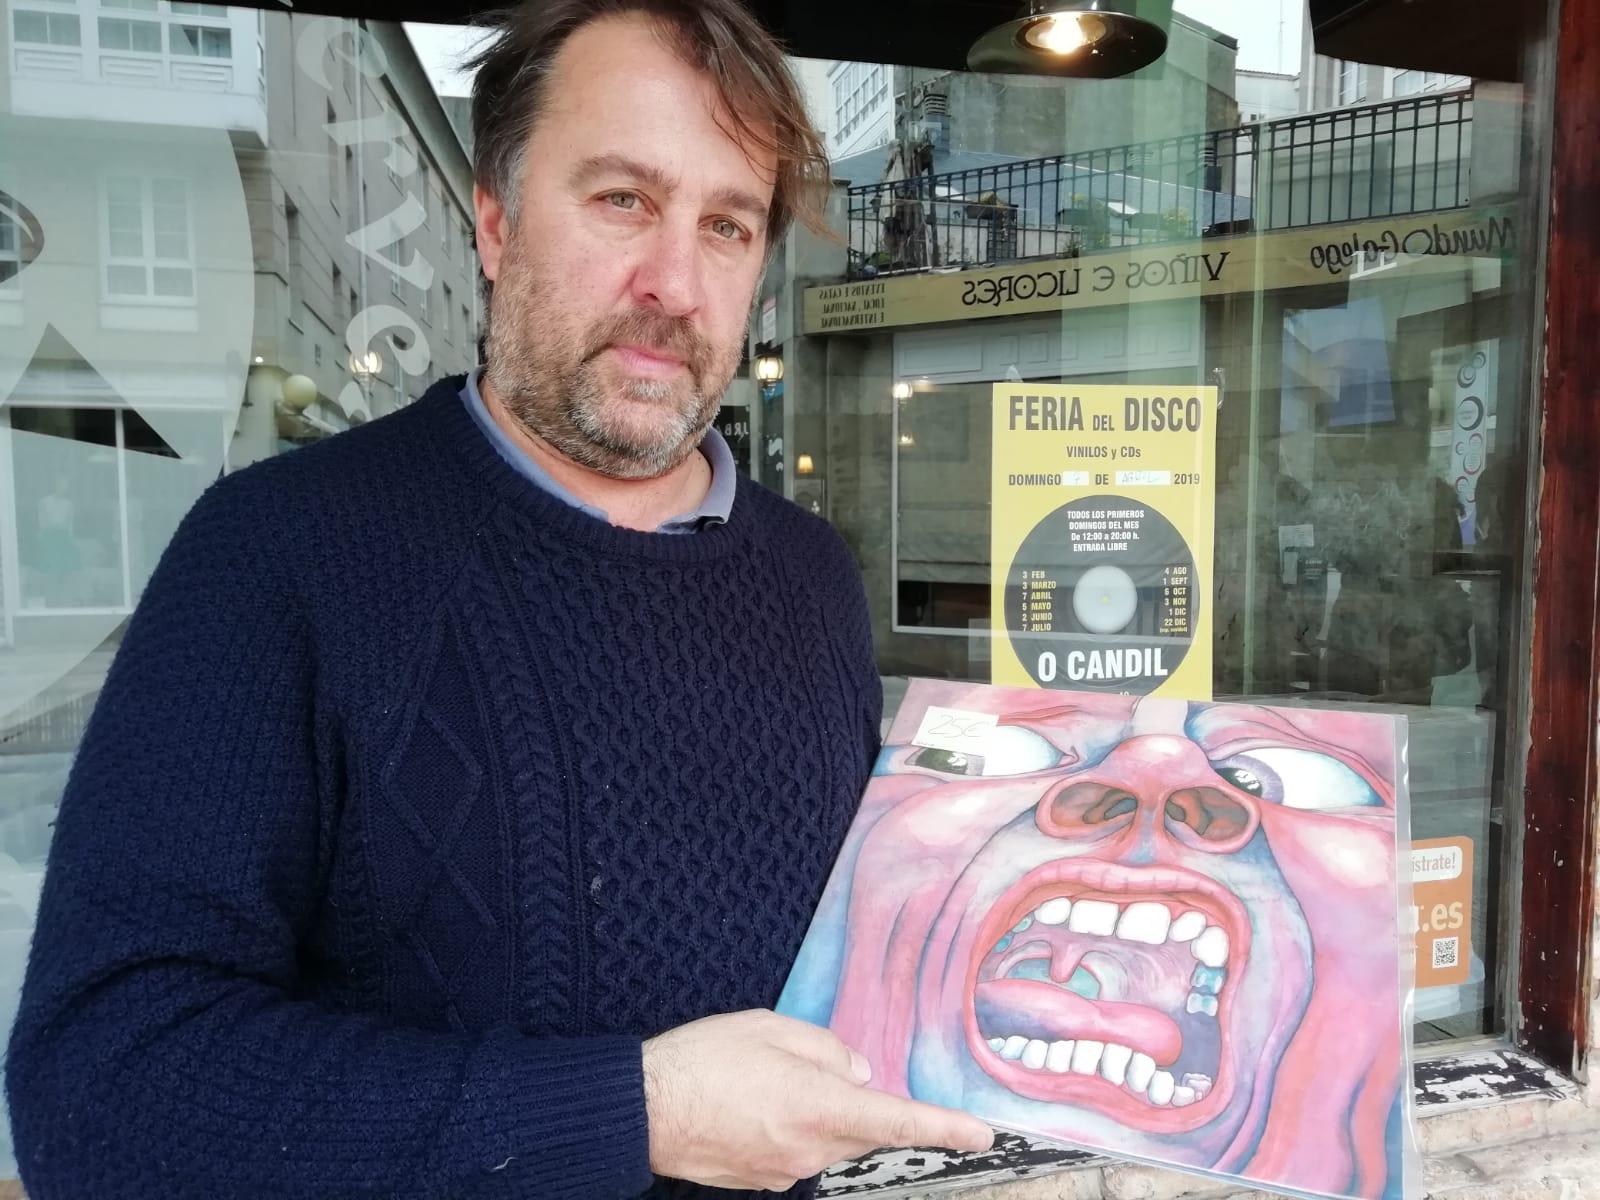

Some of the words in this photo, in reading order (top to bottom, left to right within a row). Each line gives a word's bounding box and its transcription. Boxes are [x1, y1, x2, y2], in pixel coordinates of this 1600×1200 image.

[1009, 395, 1084, 431] FERIA
[1092, 414, 1115, 432] DEL
[1124, 396, 1201, 432] DISCO
[1066, 446, 1108, 458] VINILOS
[1111, 448, 1117, 460] y
[1120, 446, 1141, 458] CDs
[1008, 474, 1061, 486] DOMINGO
[1095, 474, 1109, 485] DE
[1174, 473, 1200, 485] 2019
[1067, 510, 1091, 519] TODOS
[1092, 510, 1105, 519] LOS
[1107, 509, 1145, 519] PRIMEROS
[1069, 521, 1107, 530] DOMINGOS
[1109, 521, 1122, 530] DEL
[1124, 520, 1139, 530] MES
[1071, 532, 1081, 541] De
[1082, 532, 1102, 541] 12:00
[1111, 531, 1132, 540] 20:00
[1073, 543, 1105, 552] ENTRADA
[1107, 542, 1128, 551] LIBRE
[1022, 571, 1028, 579] 3
[1031, 571, 1045, 579] FEB
[1173, 566, 1187, 575] AGO
[1022, 581, 1028, 590] 3
[1031, 581, 1057, 590] MARZO
[1171, 577, 1187, 585] SEPT
[1022, 592, 1028, 600] 7
[1031, 591, 1053, 600] ABRIL
[1172, 587, 1186, 595] OCT
[1031, 602, 1051, 611] MAYO
[1174, 607, 1187, 615] DIC
[1022, 613, 1028, 621] 2
[1031, 613, 1053, 621] JUNIO
[1164, 618, 1173, 626] 22
[1174, 618, 1187, 626] DIC
[1022, 623, 1028, 632] 7
[1031, 623, 1052, 632] JULIO
[1038, 651, 1057, 682] O
[1067, 648, 1169, 681] CANDIL
